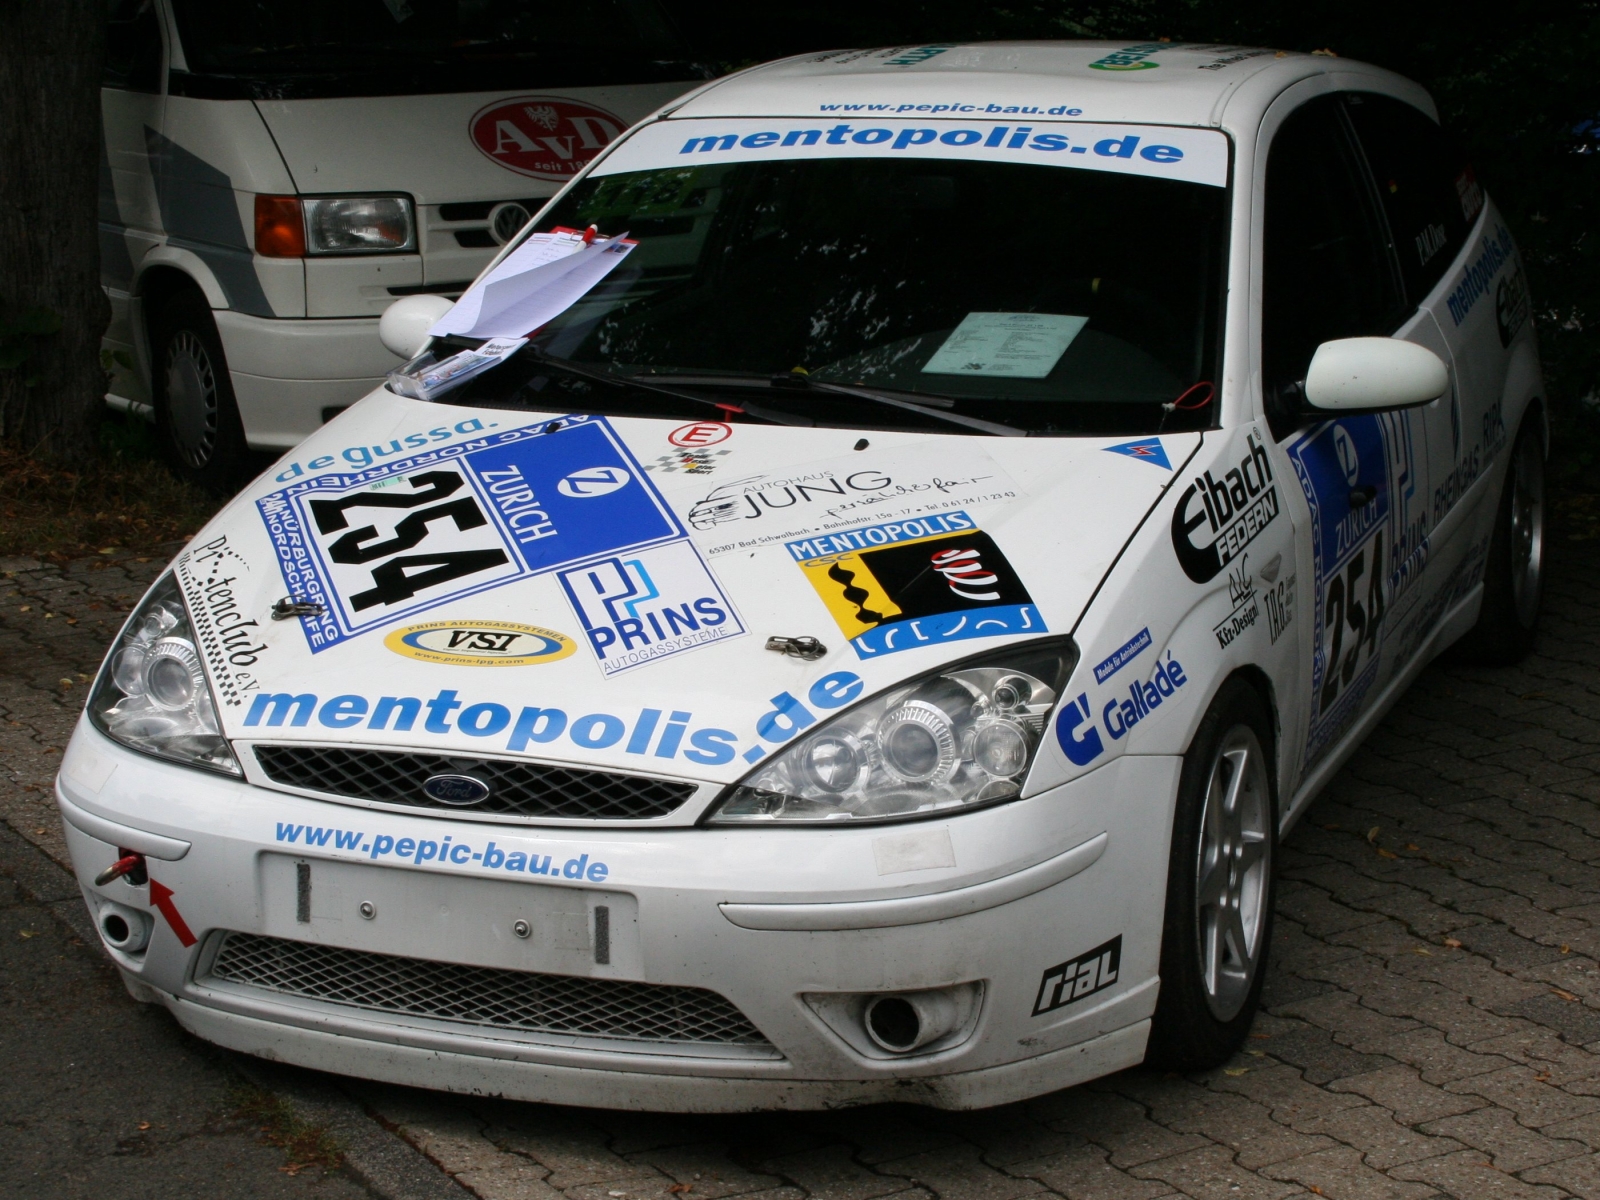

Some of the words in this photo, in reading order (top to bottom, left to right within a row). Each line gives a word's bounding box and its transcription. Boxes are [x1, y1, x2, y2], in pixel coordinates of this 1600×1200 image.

[820, 102, 1083, 117] www.pepic-bau.de
[534, 160, 562, 171] seit
[678, 123, 1184, 164] mentopolis.de
[681, 426, 719, 443] E
[287, 439, 489, 496] NORDRHEIN
[743, 471, 835, 494] AUTOHAUS
[481, 464, 557, 544] ZURICH
[744, 471, 892, 519] JUNG
[1171, 433, 1273, 584] Eibach
[309, 470, 510, 613] 254
[709, 543, 736, 555] 65307
[738, 538, 757, 548] Bad
[758, 527, 810, 544] Schwalbach
[823, 514, 875, 531] Bahnhofstr.
[925, 502, 941, 511] Tel.
[790, 513, 972, 560] MENTOPOLIS
[1215, 490, 1276, 567] FEDERN
[267, 514, 326, 648] NORDSCHIFE
[280, 509, 339, 641] NÜRBURGRING
[804, 553, 853, 567] CSC
[408, 621, 446, 631] PRINS
[451, 621, 567, 642] AUTOGASSYSTEMEN
[447, 630, 523, 651] VSI
[586, 597, 727, 660] PRINS
[1320, 529, 1385, 716] 254
[414, 652, 524, 664] www.prins-lpg.com
[603, 626, 729, 672] AUTOGASSYSTEME
[243, 670, 865, 768] mentopolis.de
[436, 780, 473, 798] Ford
[276, 822, 609, 883] www.pepic-bau.de
